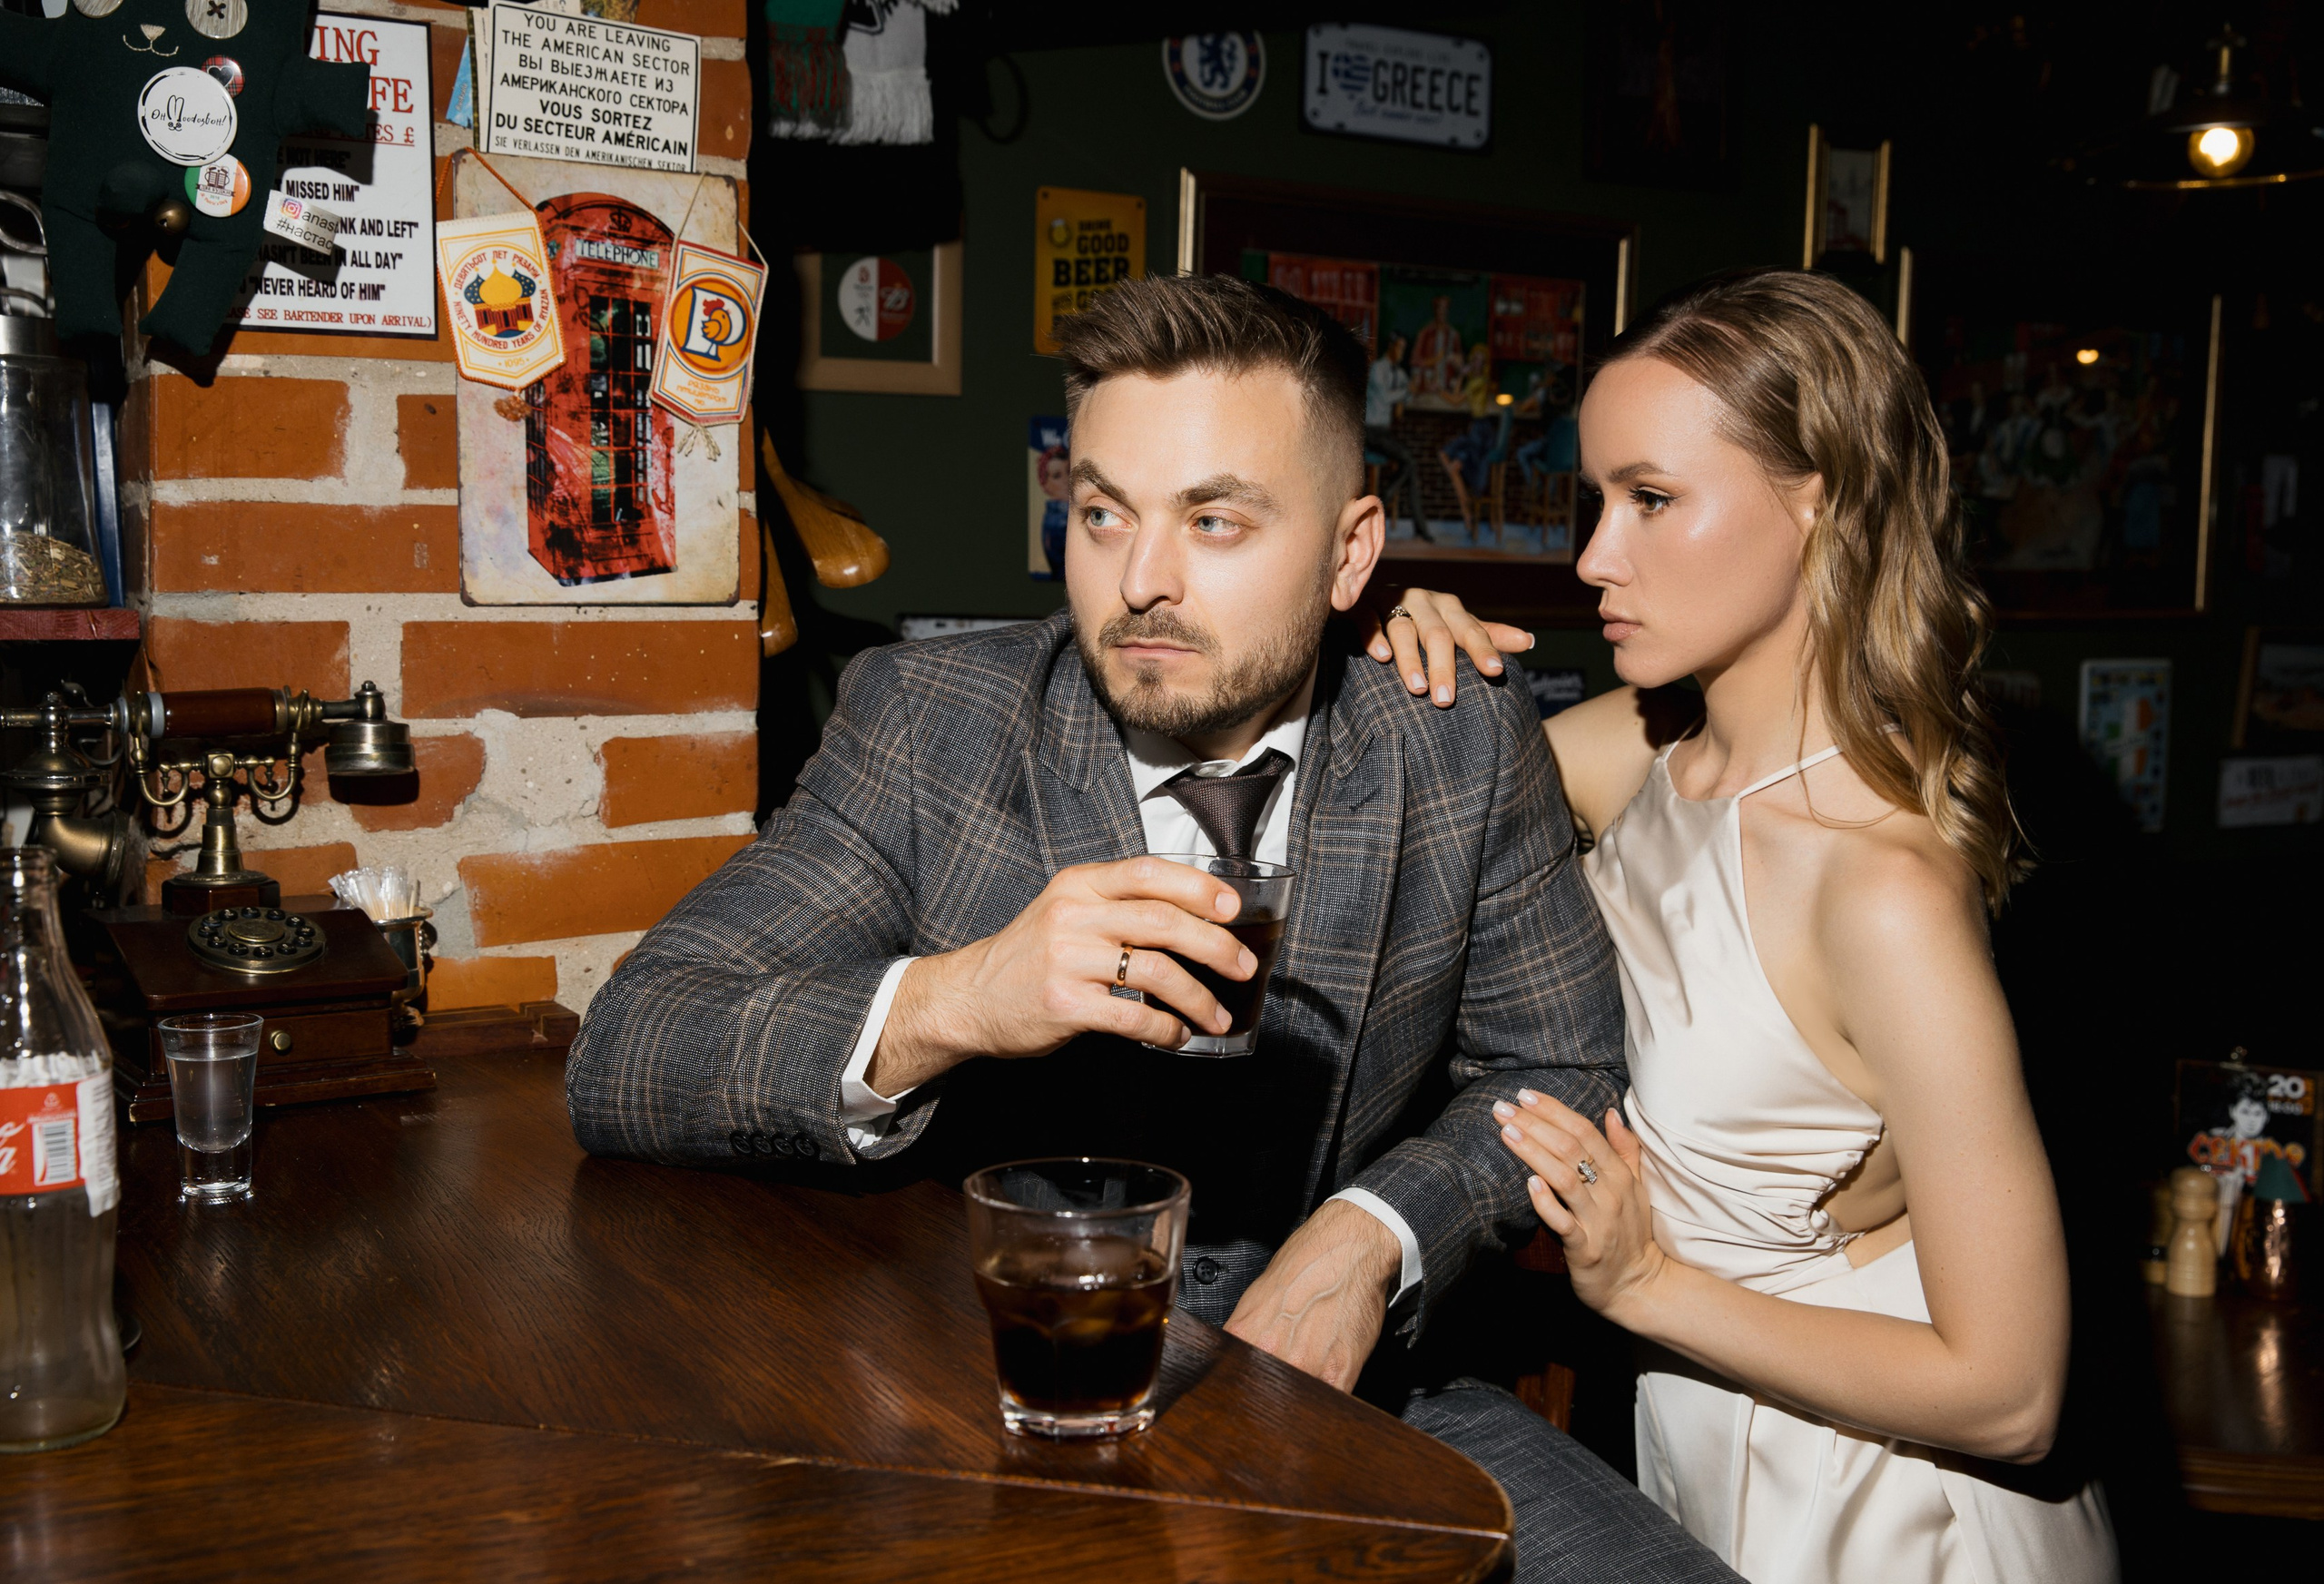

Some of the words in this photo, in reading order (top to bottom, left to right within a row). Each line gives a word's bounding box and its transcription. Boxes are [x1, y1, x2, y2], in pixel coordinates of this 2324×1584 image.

[524, 13, 556, 31] YOU
[566, 22, 596, 39] ARE
[606, 28, 671, 52] LEAVING
[502, 30, 531, 48] THE
[541, 37, 624, 64] AMERICAN
[633, 54, 690, 76] SECTOR
[519, 54, 542, 71] ВЫ
[551, 60, 646, 88] ВЫЕЗЖАЕТЕ
[655, 78, 674, 93] ИЗ
[1318, 51, 1329, 94] I
[1372, 59, 1482, 116] GREECE
[369, 76, 414, 113] FE
[500, 74, 622, 105] АМЕРИКАНСКОГО
[630, 93, 689, 116] СЕКТОРА
[539, 99, 582, 120] VOUS
[591, 111, 652, 132] SORTEZ
[496, 113, 517, 130] DU
[524, 117, 596, 143] SECTEUR
[602, 130, 687, 156] AMÉRICAIN
[495, 136, 507, 147] SIE
[513, 139, 560, 155] VERLASSEN
[565, 146, 580, 158] DEN
[585, 150, 653, 170] AMERIKANISCHEN
[285, 180, 330, 200] MISSED
[359, 218, 383, 236] AND
[1078, 233, 1129, 254] GOOD
[350, 251, 371, 269] ALL
[578, 239, 656, 268] TELEPHONE
[454, 252, 487, 290] ДЕВЯТЬСОТ
[493, 251, 507, 260] ЛЕТ
[512, 254, 540, 279] РЯЗАНИ
[1053, 257, 1129, 287] BEER
[299, 280, 337, 298] HEARD
[341, 282, 355, 299] OF
[257, 309, 277, 320] SEE
[284, 310, 344, 323] BARTENDER
[350, 314, 376, 325] UPON
[381, 314, 432, 329] ARRIVAL)
[453, 301, 472, 330] NINETY
[471, 330, 507, 349] HUNDRED
[511, 331, 535, 348] YEARS
[534, 320, 543, 332] OF
[539, 289, 549, 320] RYAZAN
[2267, 1074, 2306, 1099] 20
